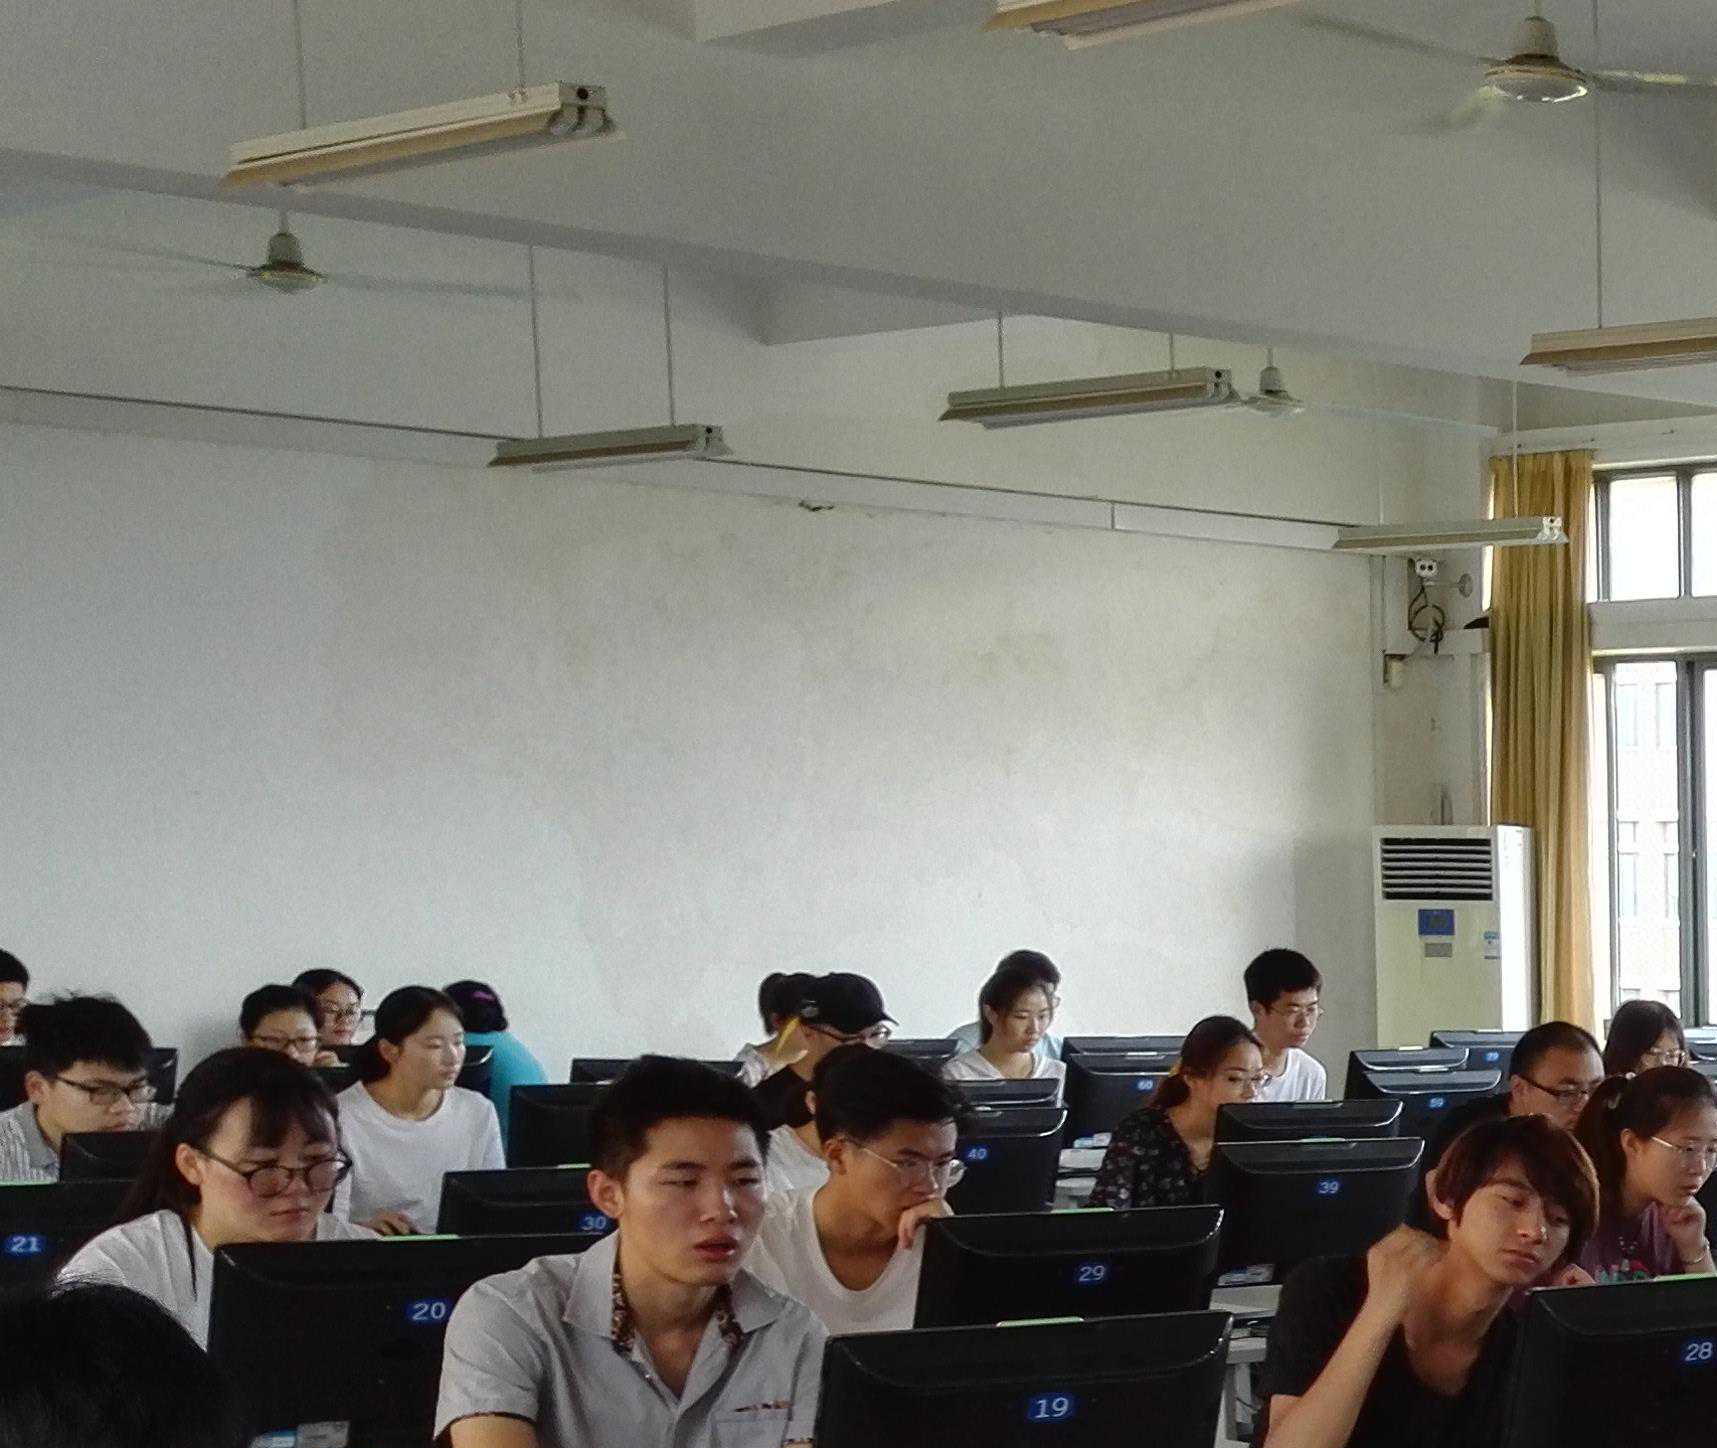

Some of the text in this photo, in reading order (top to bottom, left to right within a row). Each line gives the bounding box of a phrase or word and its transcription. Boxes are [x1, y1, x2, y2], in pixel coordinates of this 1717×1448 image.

[967, 1148, 988, 1161] 40
[1318, 1180, 1340, 1195] 39
[581, 1214, 608, 1231] 30
[10, 1235, 42, 1254] 21
[1078, 1264, 1106, 1282] 29
[412, 1301, 447, 1321] 20
[1684, 1341, 1714, 1363] 28
[1034, 1397, 1069, 1419] 19
